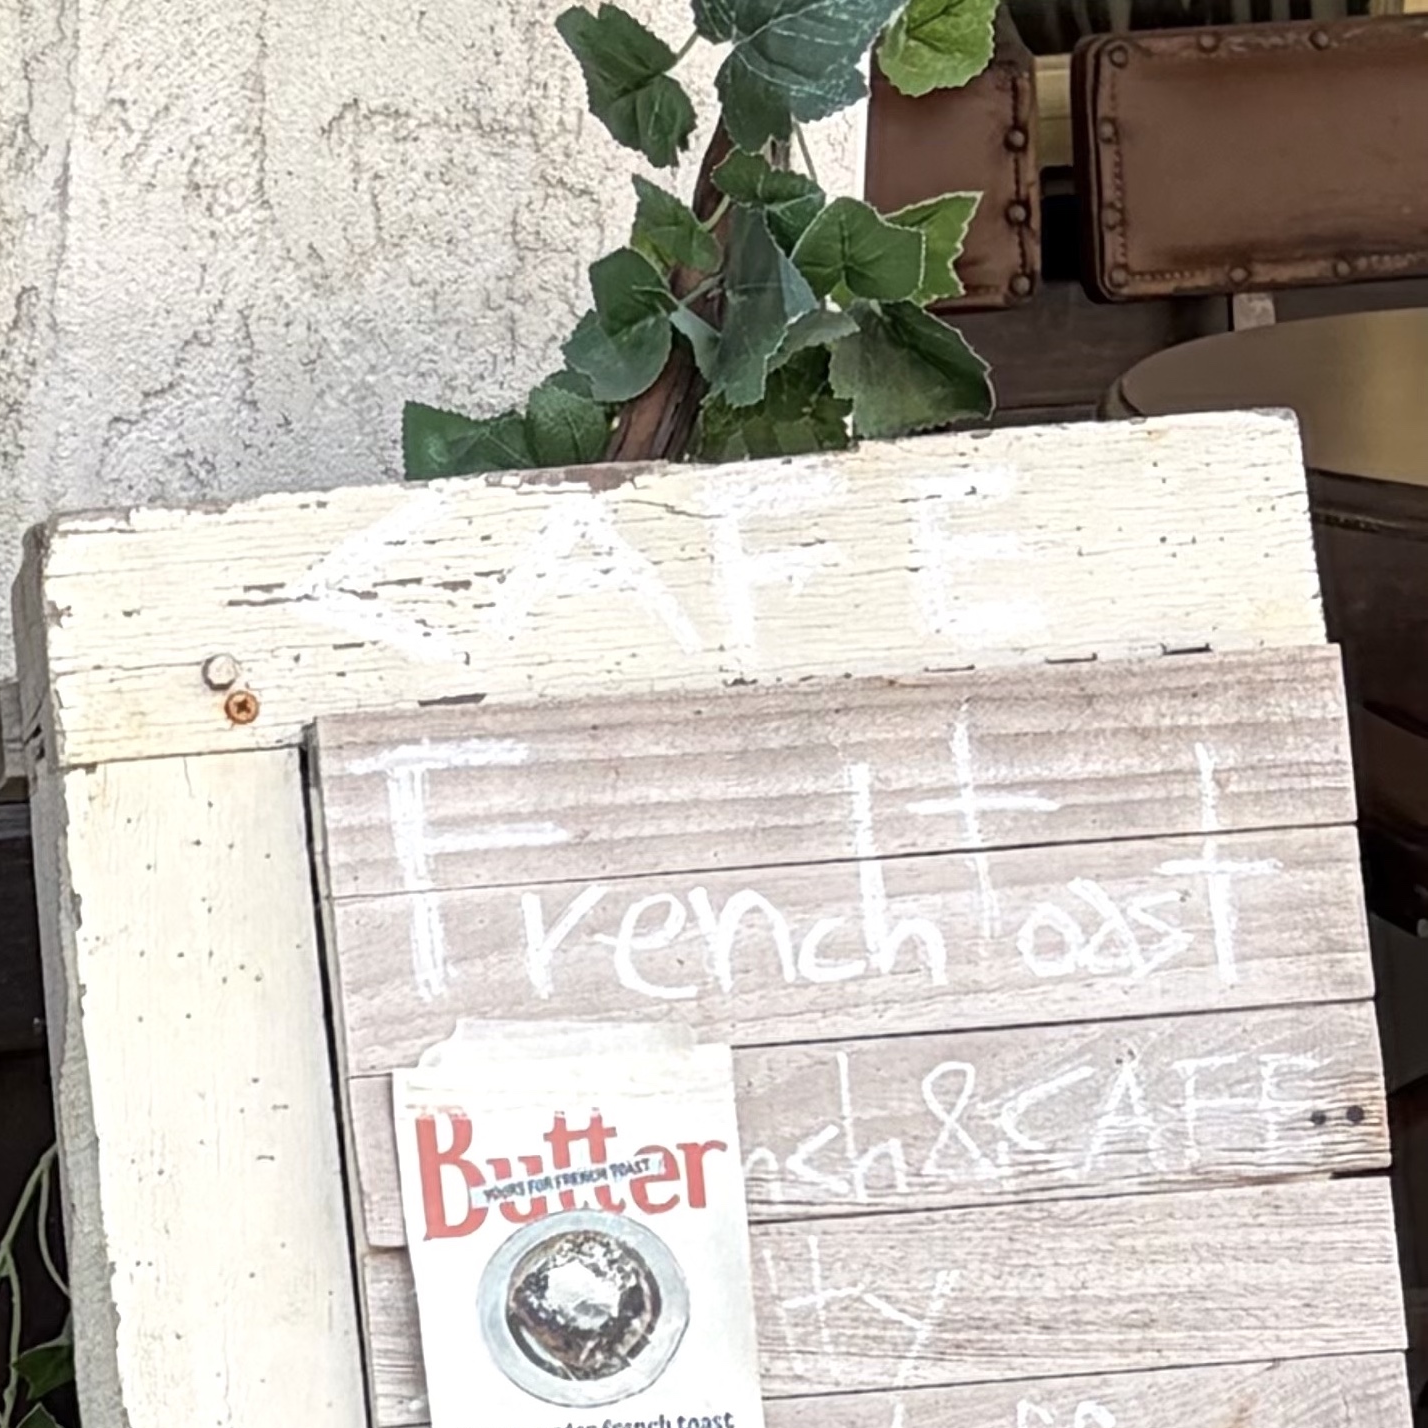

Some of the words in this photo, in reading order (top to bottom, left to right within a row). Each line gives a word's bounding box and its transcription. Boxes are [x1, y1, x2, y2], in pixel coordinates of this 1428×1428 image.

[291, 464, 1047, 668] CAFE
[345, 738, 948, 1000] French
[406, 1104, 728, 1241] Butter
